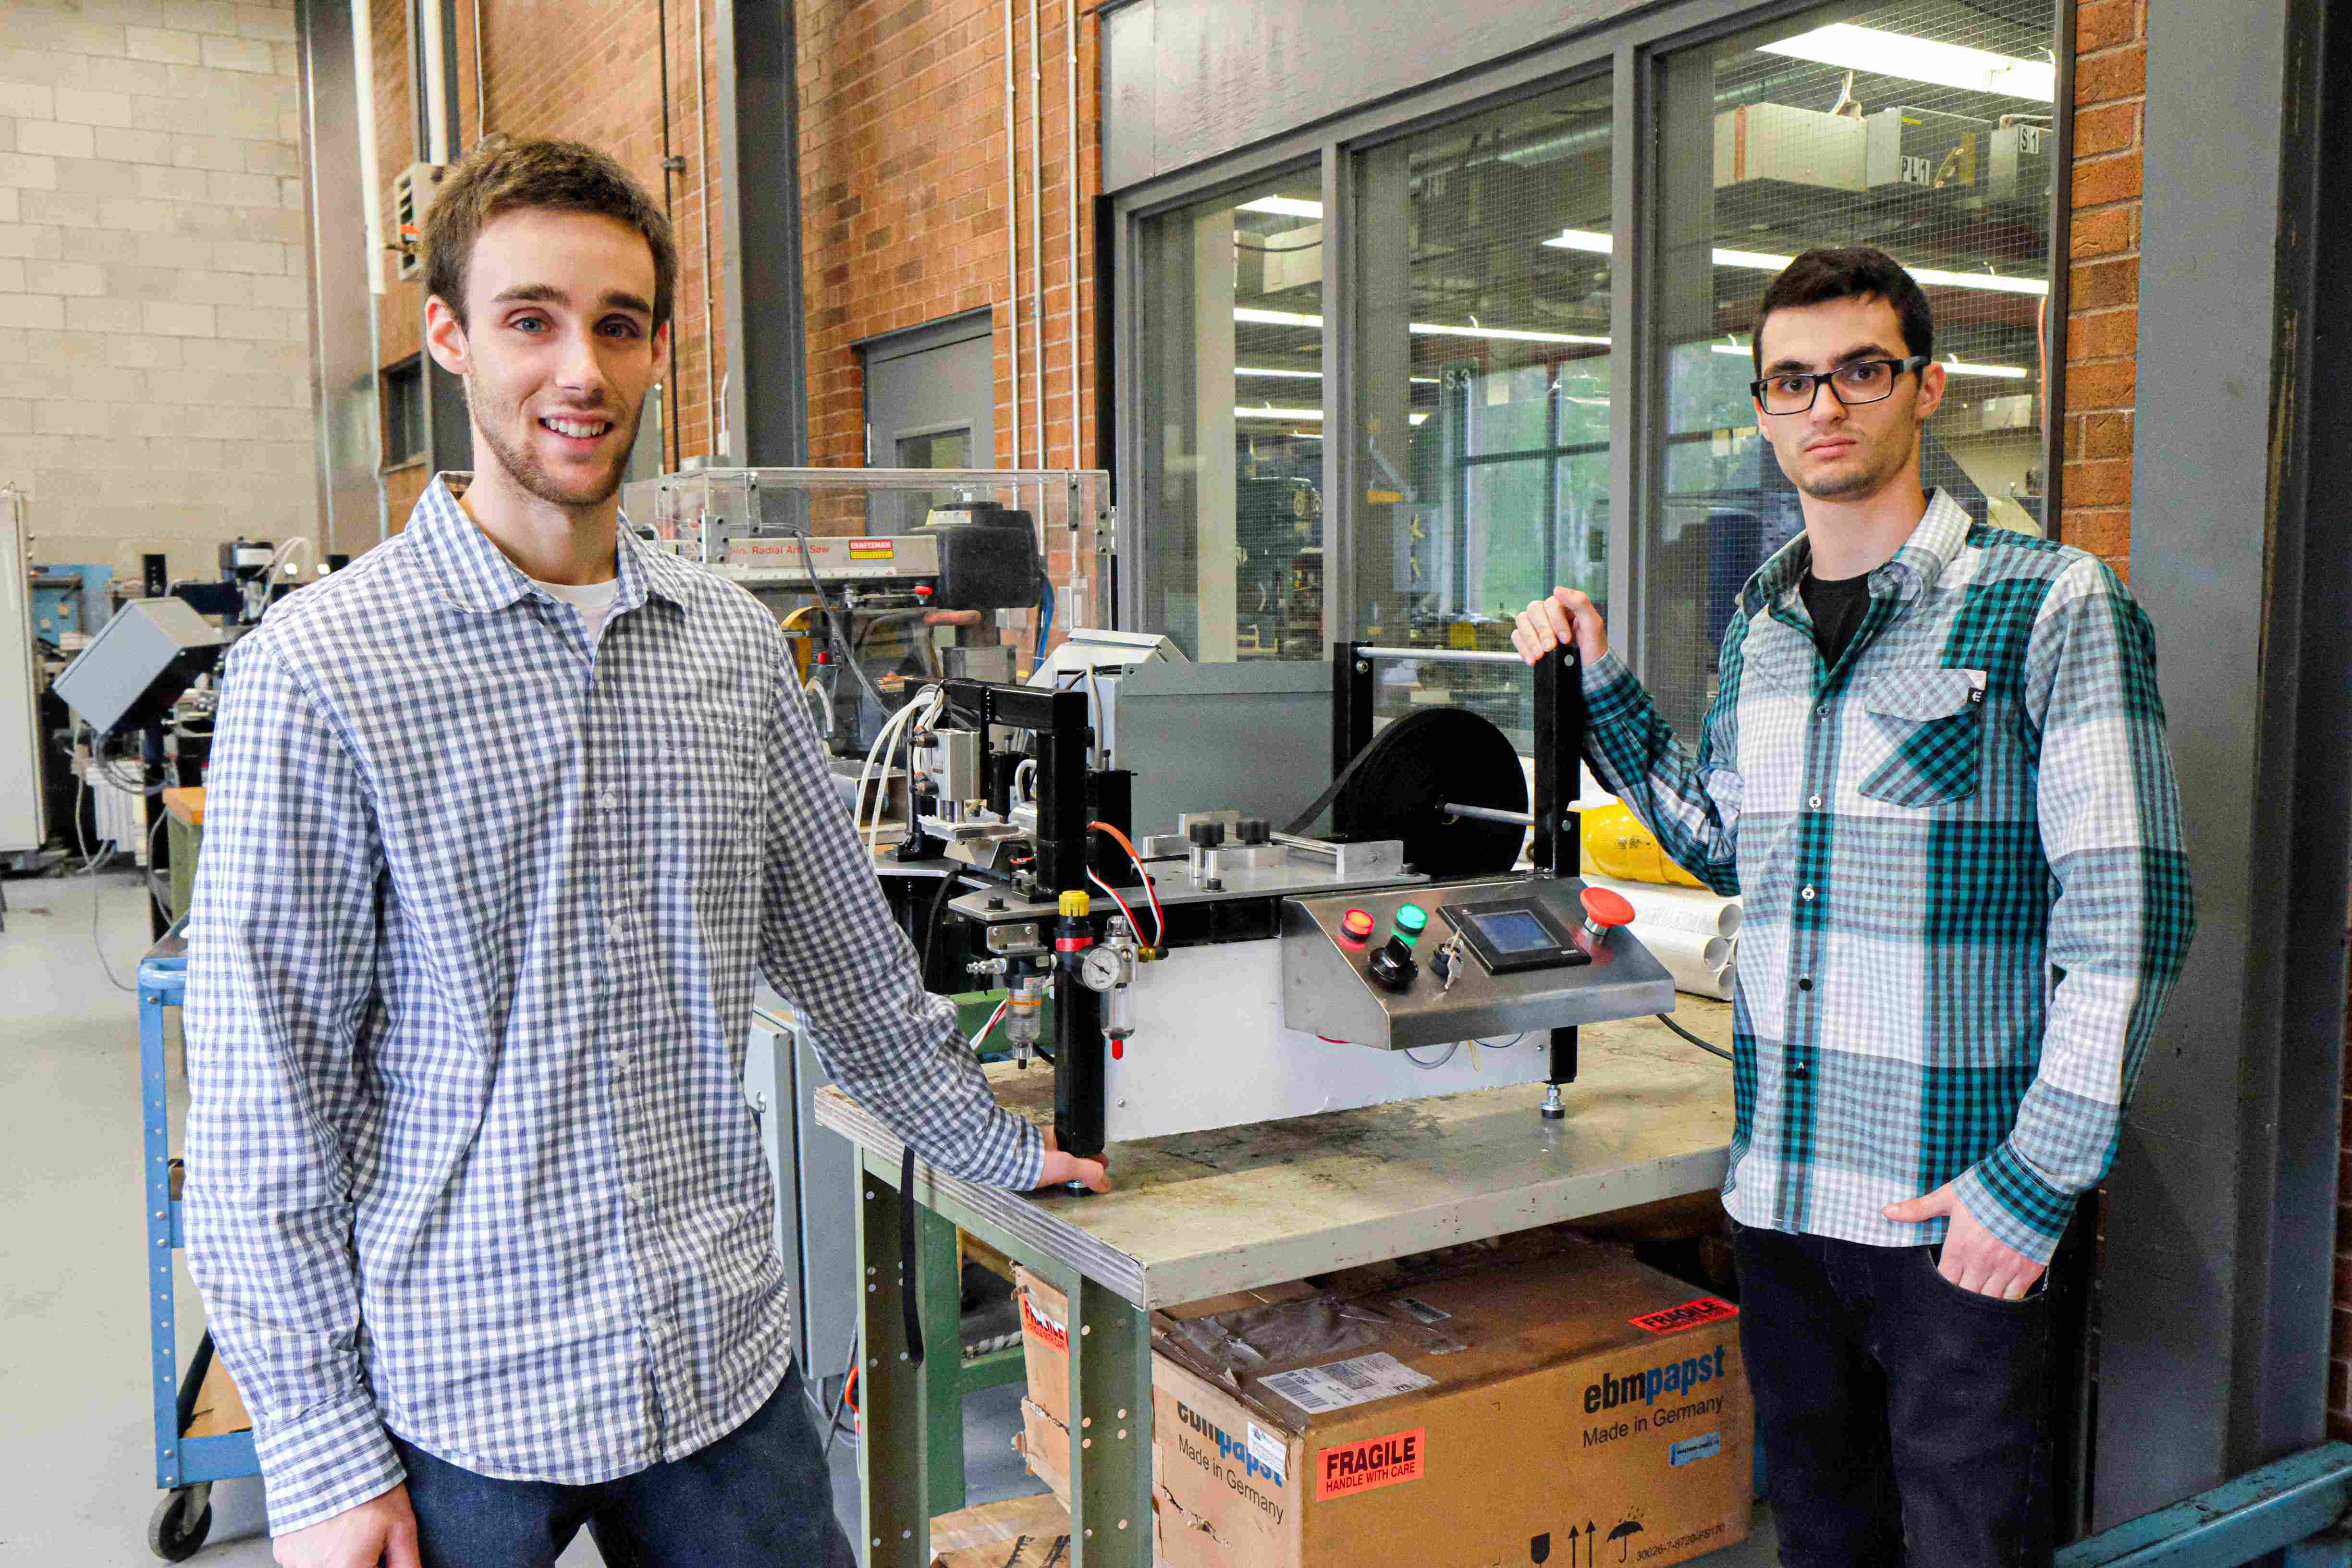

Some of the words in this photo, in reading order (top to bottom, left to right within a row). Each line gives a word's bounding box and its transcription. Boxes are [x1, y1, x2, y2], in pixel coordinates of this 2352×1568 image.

[752, 545, 783, 554] Radial
[809, 545, 829, 554] Saw
[1641, 1301, 1722, 1328] FRAGILE
[1584, 1345, 1726, 1414] ebmpapst
[1584, 1422, 1629, 1447] Made
[1635, 1416, 1647, 1433] in
[1654, 1395, 1724, 1427] Germany
[1326, 1436, 1416, 1479] FRAGILE
[1326, 1474, 1363, 1493] HANDLE
[1366, 1468, 1388, 1483] WITH
[1391, 1462, 1415, 1478] CARE
[1179, 1434, 1209, 1470] Made
[1213, 1458, 1223, 1481] in
[1227, 1469, 1284, 1525] Germany
